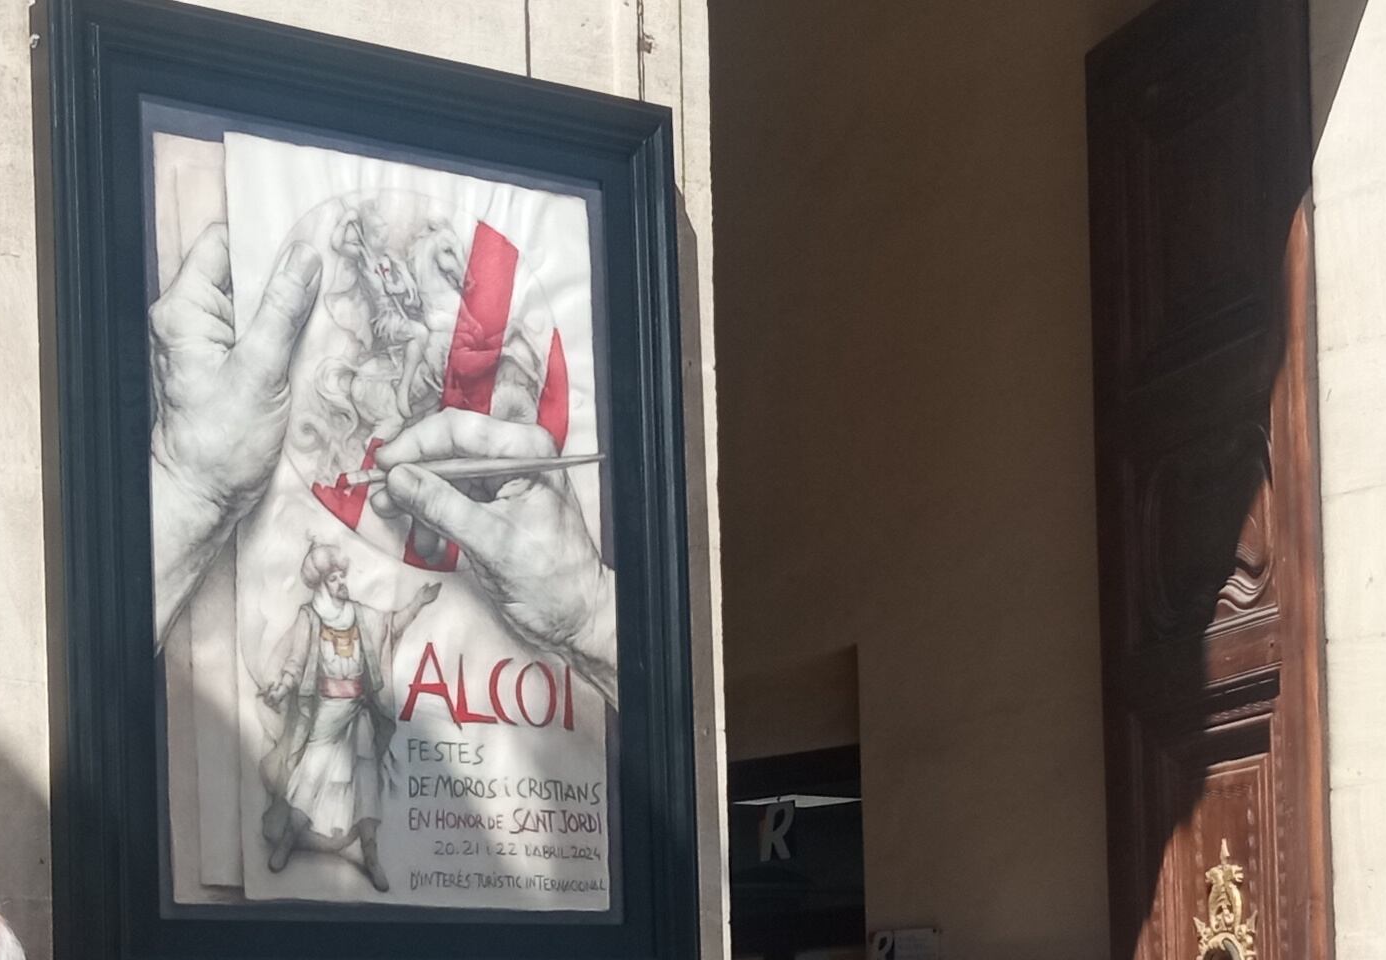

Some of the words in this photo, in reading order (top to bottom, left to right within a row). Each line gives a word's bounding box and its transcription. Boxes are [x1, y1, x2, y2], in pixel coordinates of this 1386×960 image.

[399, 642, 574, 731] ALCOI
[407, 738, 484, 765] FESTES
[408, 776, 431, 799] DE
[434, 775, 497, 799] MOROS
[517, 776, 602, 805] CRISTIANS
[408, 807, 431, 831] EN
[435, 809, 485, 830] HONOR
[488, 815, 503, 829] DE
[509, 808, 556, 834] SANT
[558, 809, 602, 834] JORDI
[495, 842, 518, 857] 22
[571, 845, 601, 860] 2024
